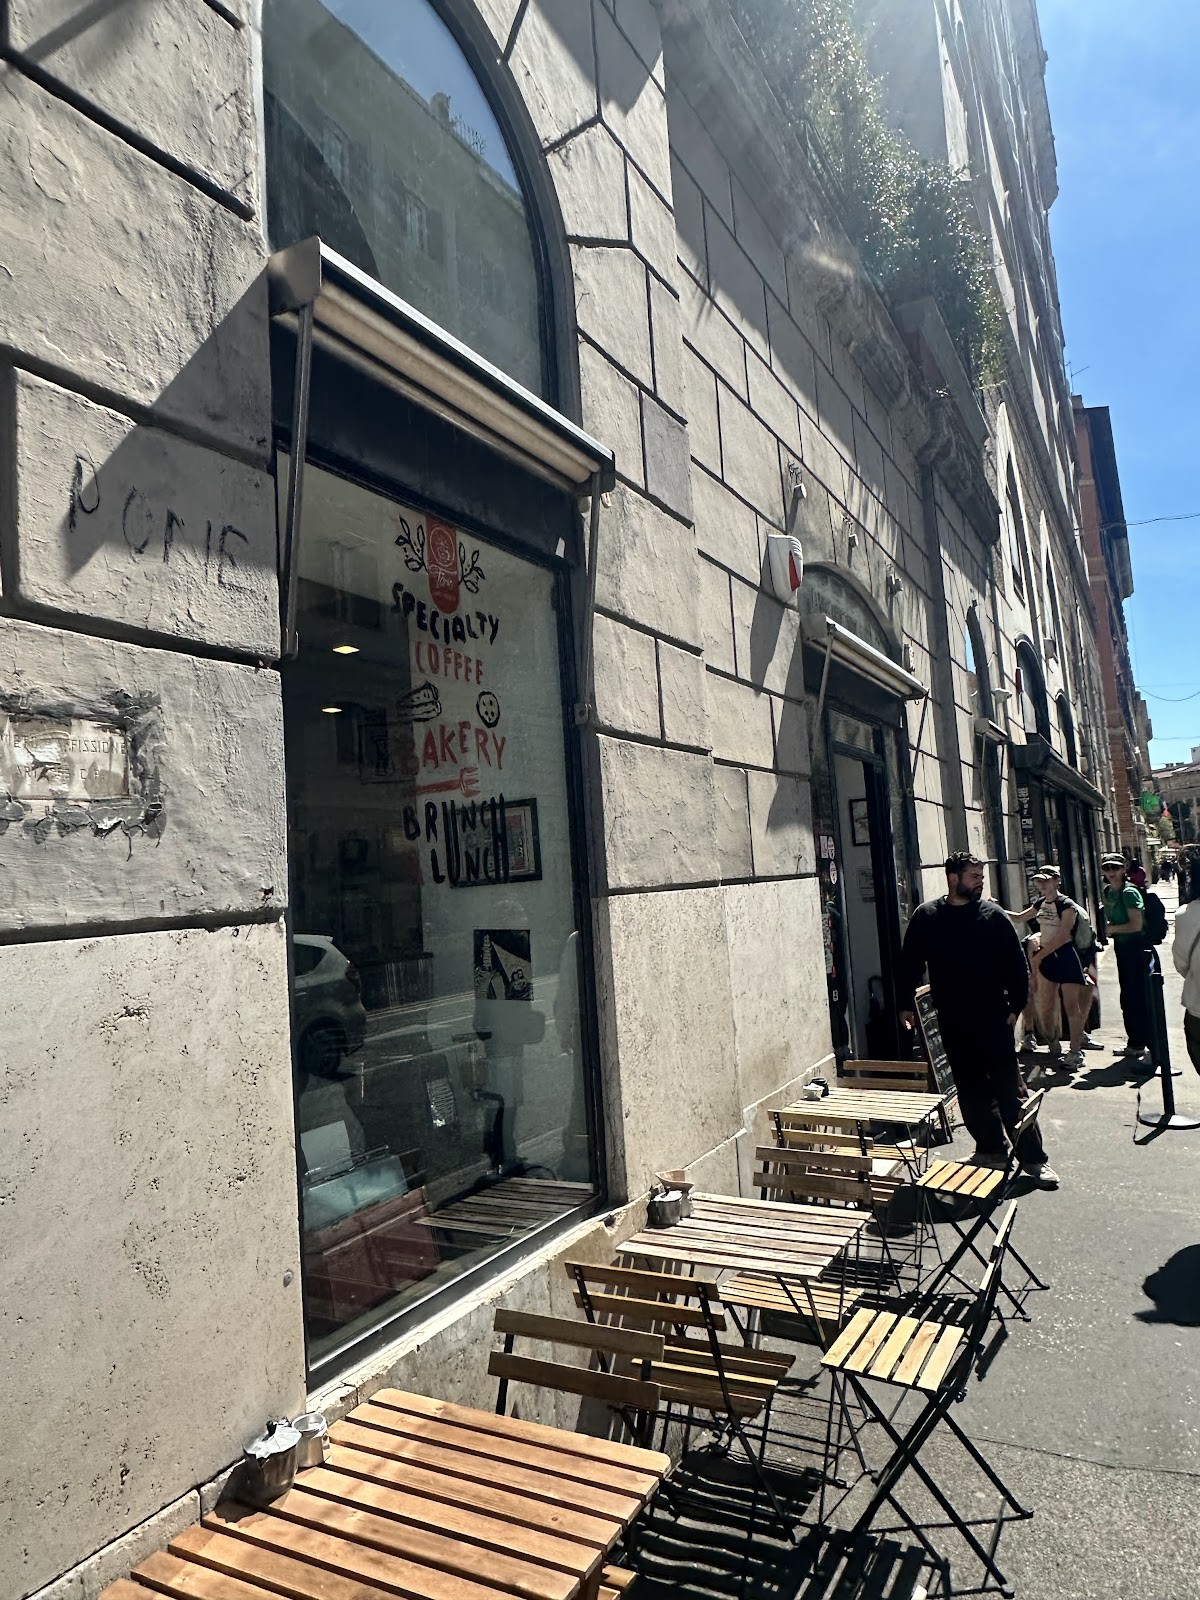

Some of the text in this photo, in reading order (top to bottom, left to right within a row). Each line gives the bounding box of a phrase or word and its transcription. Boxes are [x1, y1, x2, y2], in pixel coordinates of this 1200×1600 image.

[391, 581, 500, 646] SPECIALTY
[414, 640, 484, 685] COFFEE
[402, 793, 510, 852] BRUNCH
[430, 835, 510, 888] LUNCH
